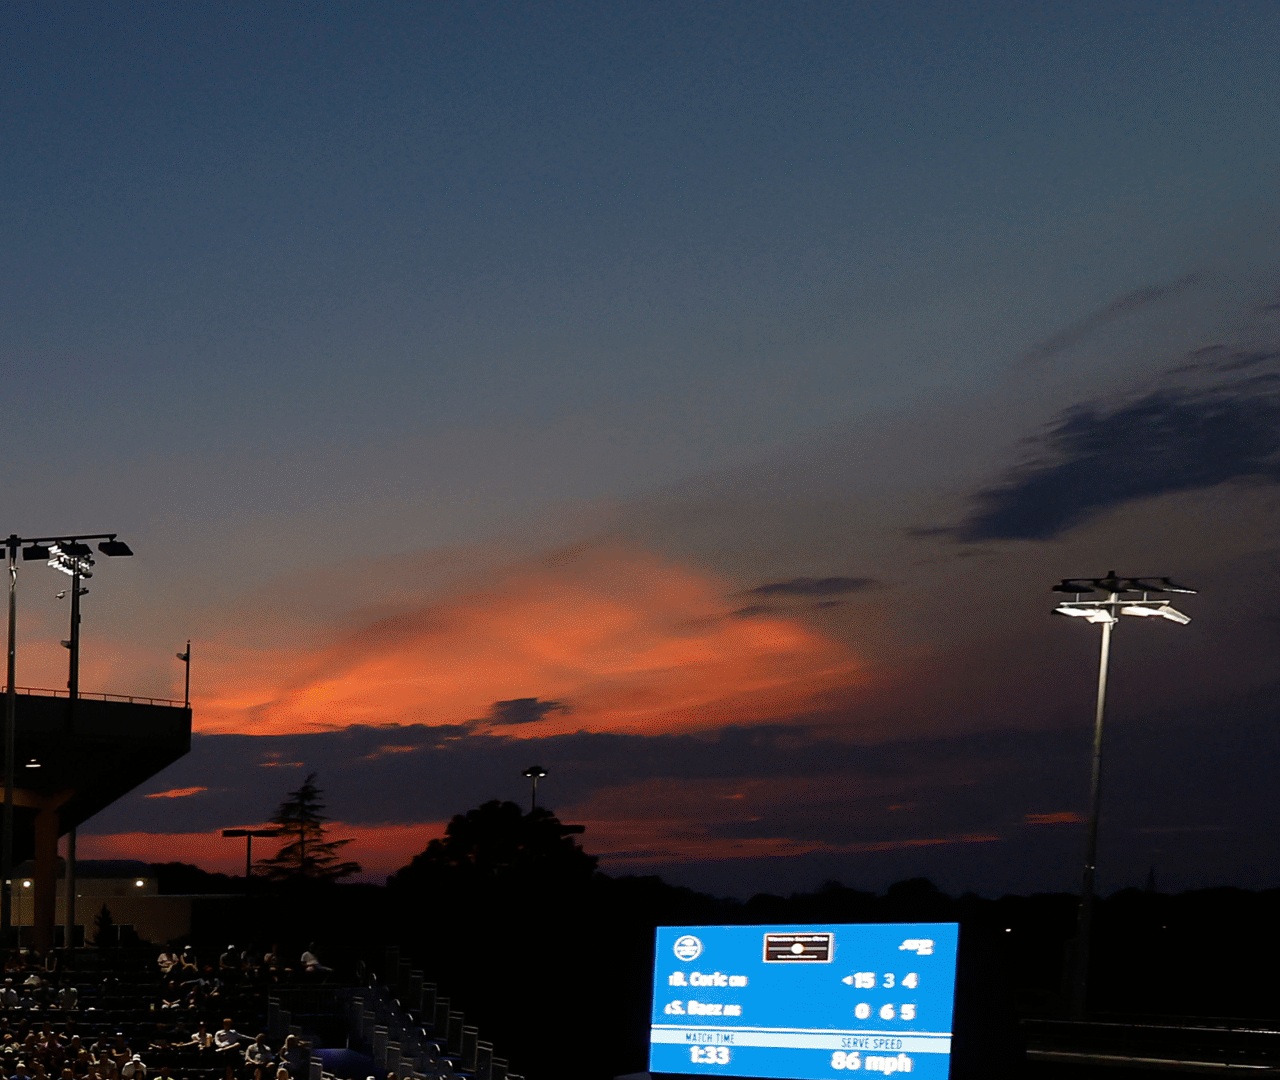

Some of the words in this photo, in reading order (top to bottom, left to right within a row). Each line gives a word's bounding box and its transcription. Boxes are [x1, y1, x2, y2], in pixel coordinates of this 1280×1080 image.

[690, 971, 728, 987] Coric
[854, 972, 876, 989] 15
[883, 973, 895, 989] 3
[901, 972, 918, 989] 4
[854, 1003, 871, 1020] 0
[879, 1003, 895, 1020] 6
[900, 1004, 916, 1020] 5
[685, 1032, 713, 1043] MATCH
[716, 1033, 735, 1044] TIME
[841, 1037, 870, 1048] SERVE
[873, 1038, 903, 1050] SPEED
[690, 1045, 731, 1065] 1:33
[831, 1051, 861, 1070] 86
[865, 1053, 913, 1076] mph
